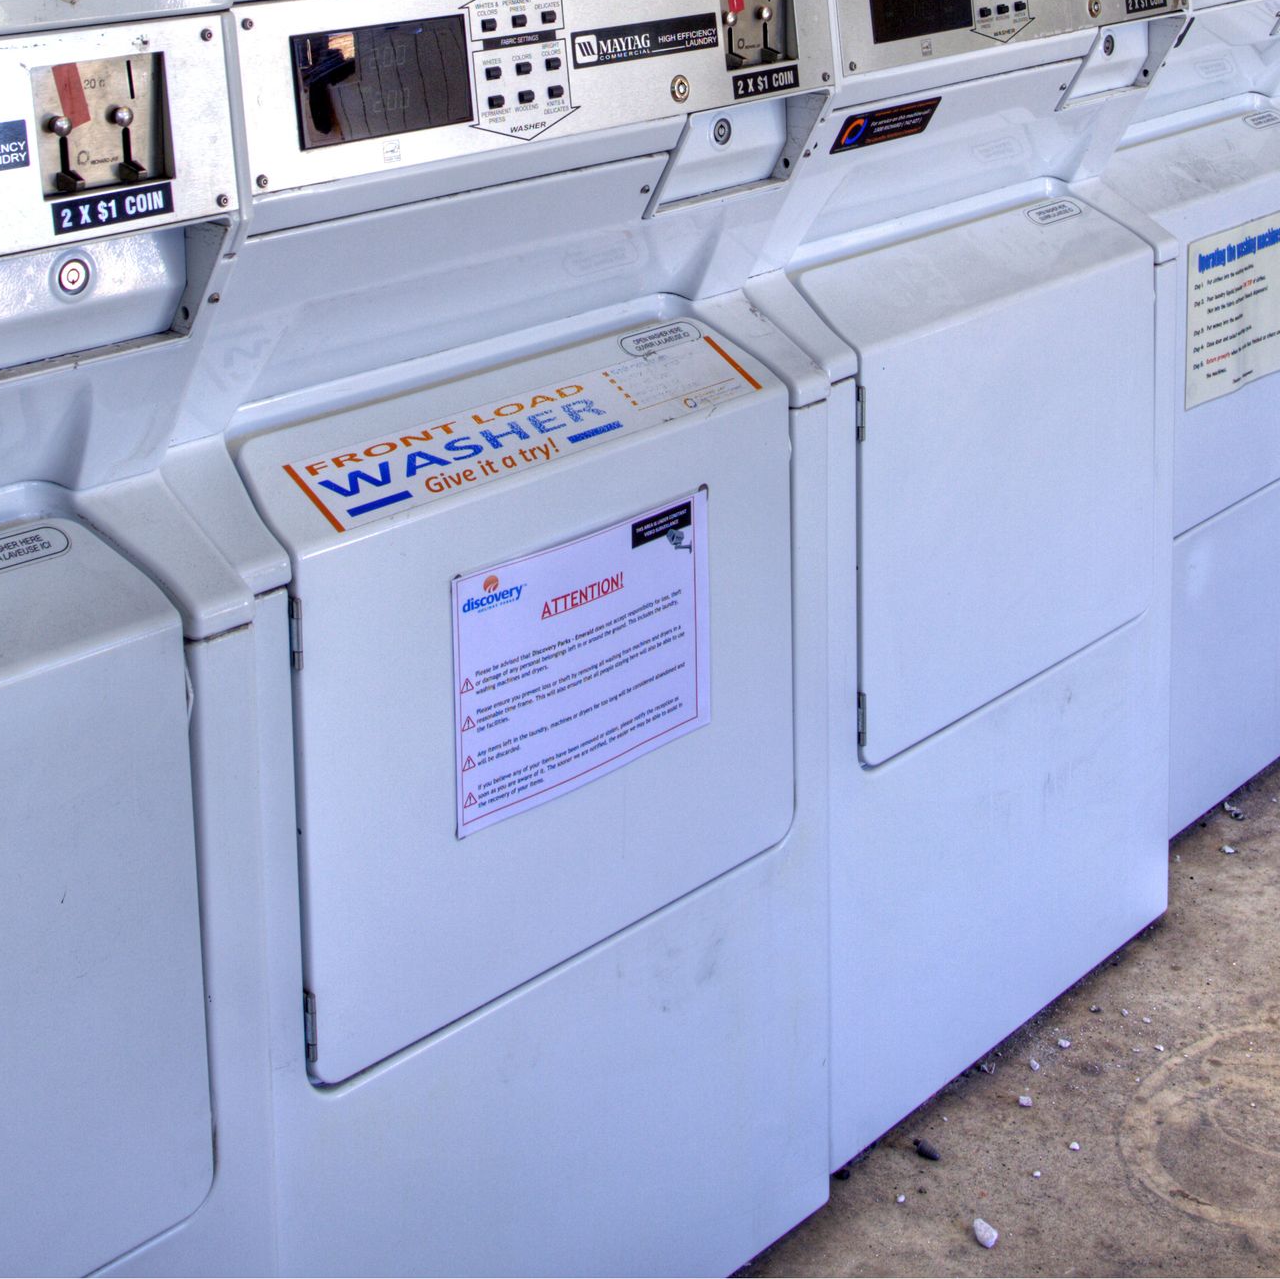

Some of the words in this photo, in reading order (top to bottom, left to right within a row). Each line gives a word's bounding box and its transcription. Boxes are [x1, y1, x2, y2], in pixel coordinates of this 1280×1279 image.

[534, 1, 560, 10] DELICATES
[599, 33, 650, 54] MAYTAG
[658, 34, 676, 44] HIGH
[677, 27, 717, 41] EFFICIENCY
[685, 36, 717, 48] LAUNDRY
[599, 47, 651, 61] COMMERCIAL
[738, 82, 744, 95] 2
[747, 79, 754, 93] X
[757, 76, 769, 91] $1
[772, 70, 794, 86] COIN
[510, 121, 546, 134] WASHER
[61, 208, 73, 228] 2
[78, 204, 92, 225] X
[97, 199, 117, 222] $1
[124, 190, 164, 215] COIN
[305, 420, 456, 476] FRONT
[471, 384, 583, 425] LOAD
[317, 398, 607, 498] WASHER
[424, 466, 477, 495] Give
[480, 458, 498, 478] it
[501, 456, 518, 469] a
[519, 437, 560, 468] try!
[3, 544, 39, 562] LAVEUSE
[41, 540, 52, 551] ICI
[20, 534, 43, 548] HERE
[462, 584, 523, 614] discovery
[541, 571, 624, 619] ATTENTION!
